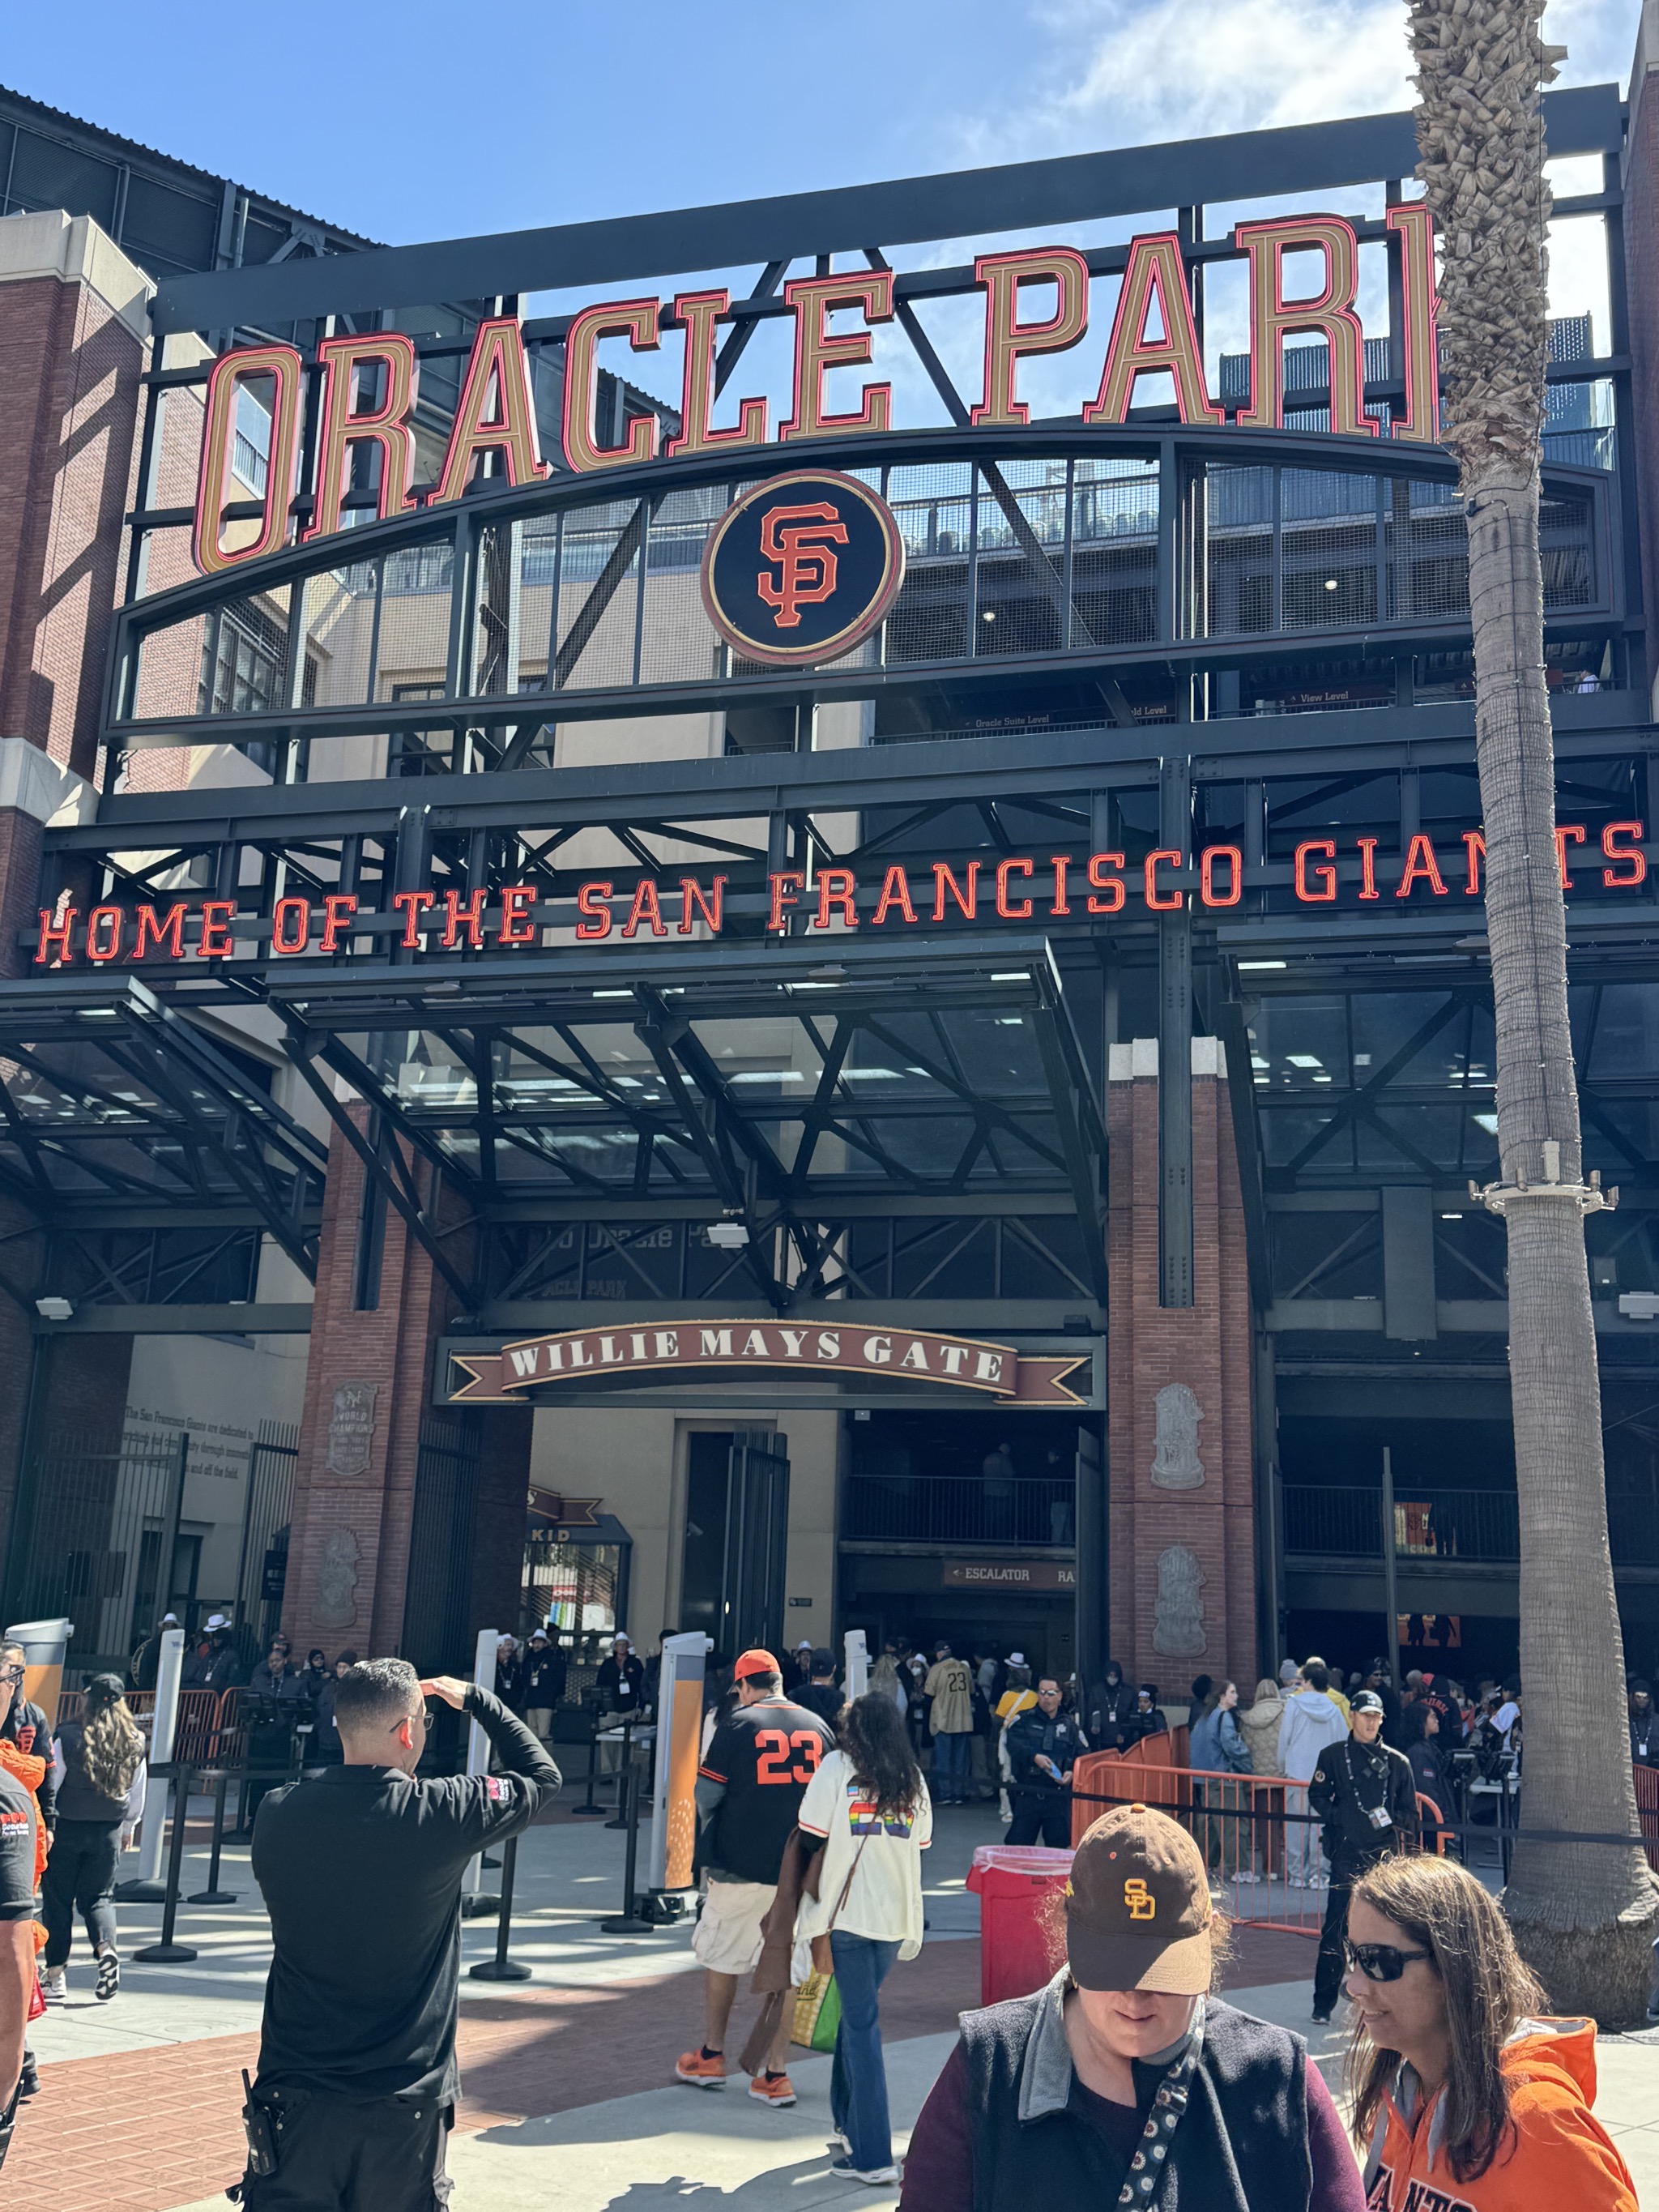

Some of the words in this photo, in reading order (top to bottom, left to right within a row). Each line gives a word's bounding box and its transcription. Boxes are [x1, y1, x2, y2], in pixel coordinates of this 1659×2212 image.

[193, 267, 895, 575] ORACLE
[1300, 694, 1323, 703] View
[1325, 691, 1349, 701] Level
[1145, 705, 1167, 715] Level
[975, 718, 1002, 728] Oracle
[1004, 716, 1026, 726] Suite
[1027, 714, 1050, 724] Level
[34, 899, 236, 963] HOME
[272, 895, 357, 954] OF
[394, 886, 537, 947] THE
[577, 875, 727, 940] SAN
[768, 845, 1243, 930] FRANCISCO
[510, 1330, 680, 1377] WILLIE
[699, 1328, 841, 1360] MAYS
[862, 1335, 1004, 1383] GATE
[531, 1529, 570, 1542] KID
[965, 1567, 1030, 1581] ESCALATOR
[1057, 1570, 1076, 1582] RA
[948, 1672, 967, 1693] 23
[755, 1728, 823, 1785] 23
[1124, 1877, 1156, 1921] SD
